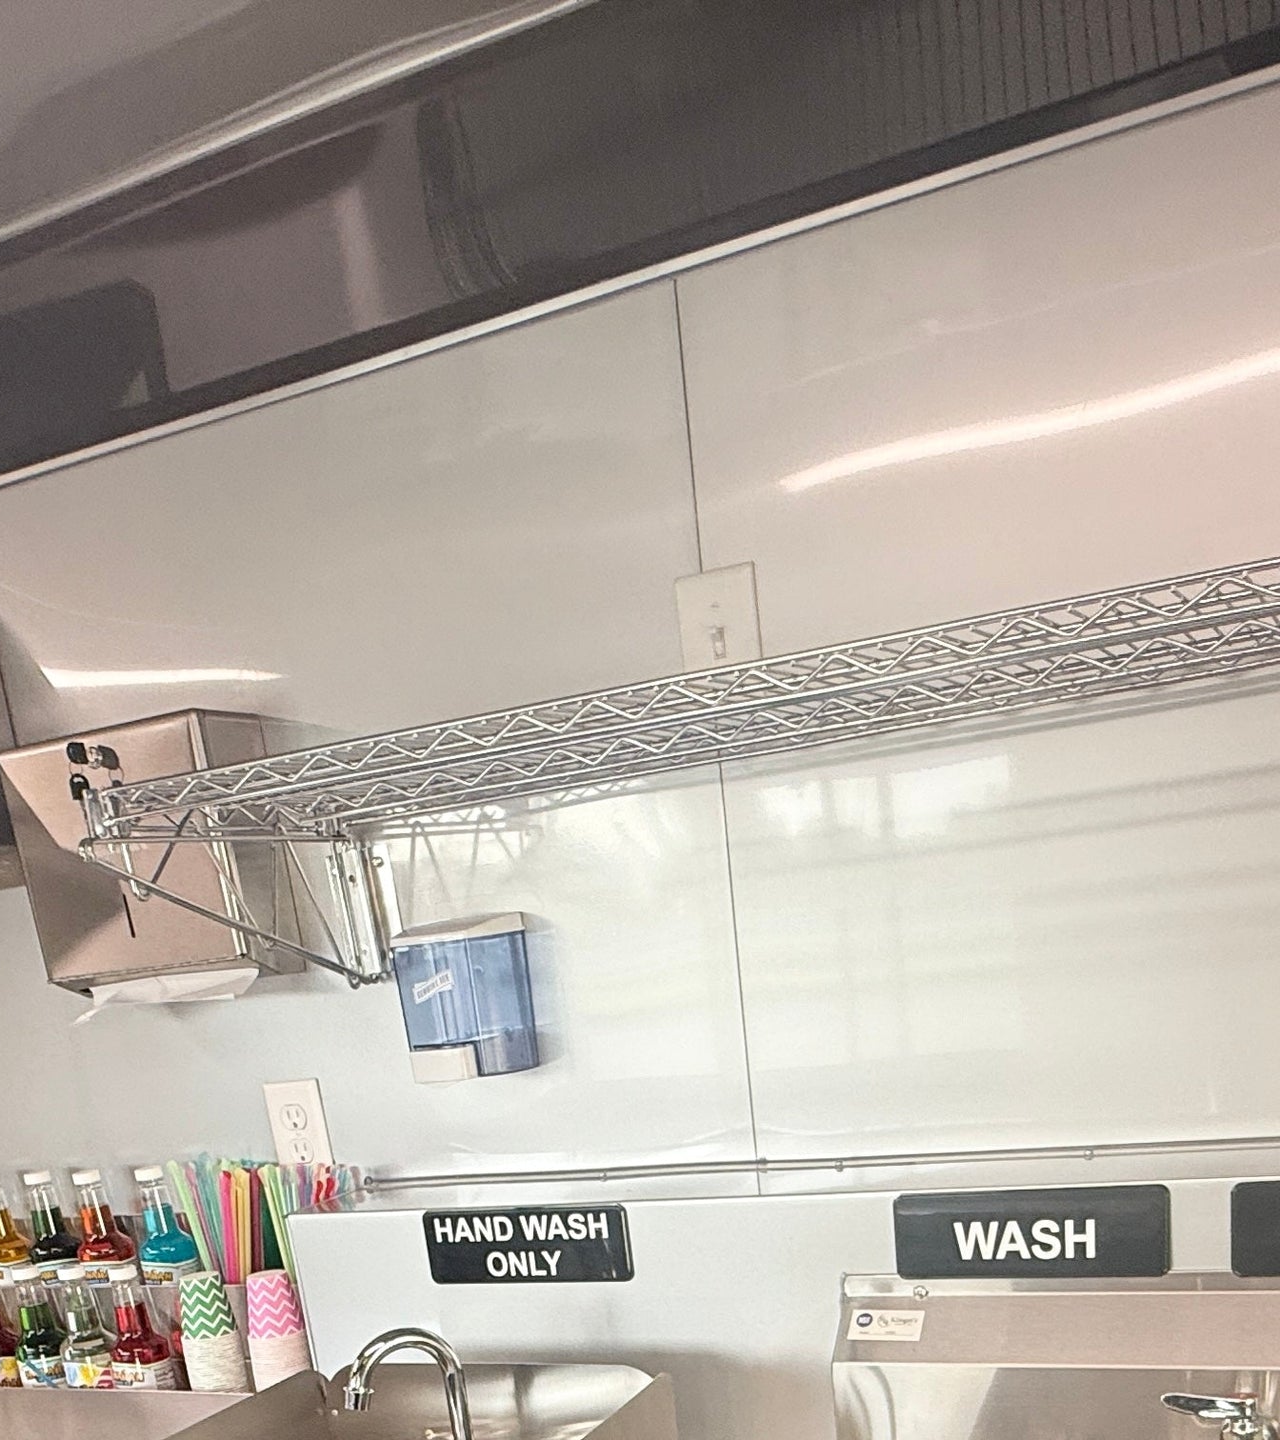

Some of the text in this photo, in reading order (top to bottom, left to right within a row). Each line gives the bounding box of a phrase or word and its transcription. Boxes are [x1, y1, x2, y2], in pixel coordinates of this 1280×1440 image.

[434, 1213, 608, 1243] HAND WASH
[953, 1219, 1096, 1260] WASH
[486, 1251, 562, 1277] ONLY
